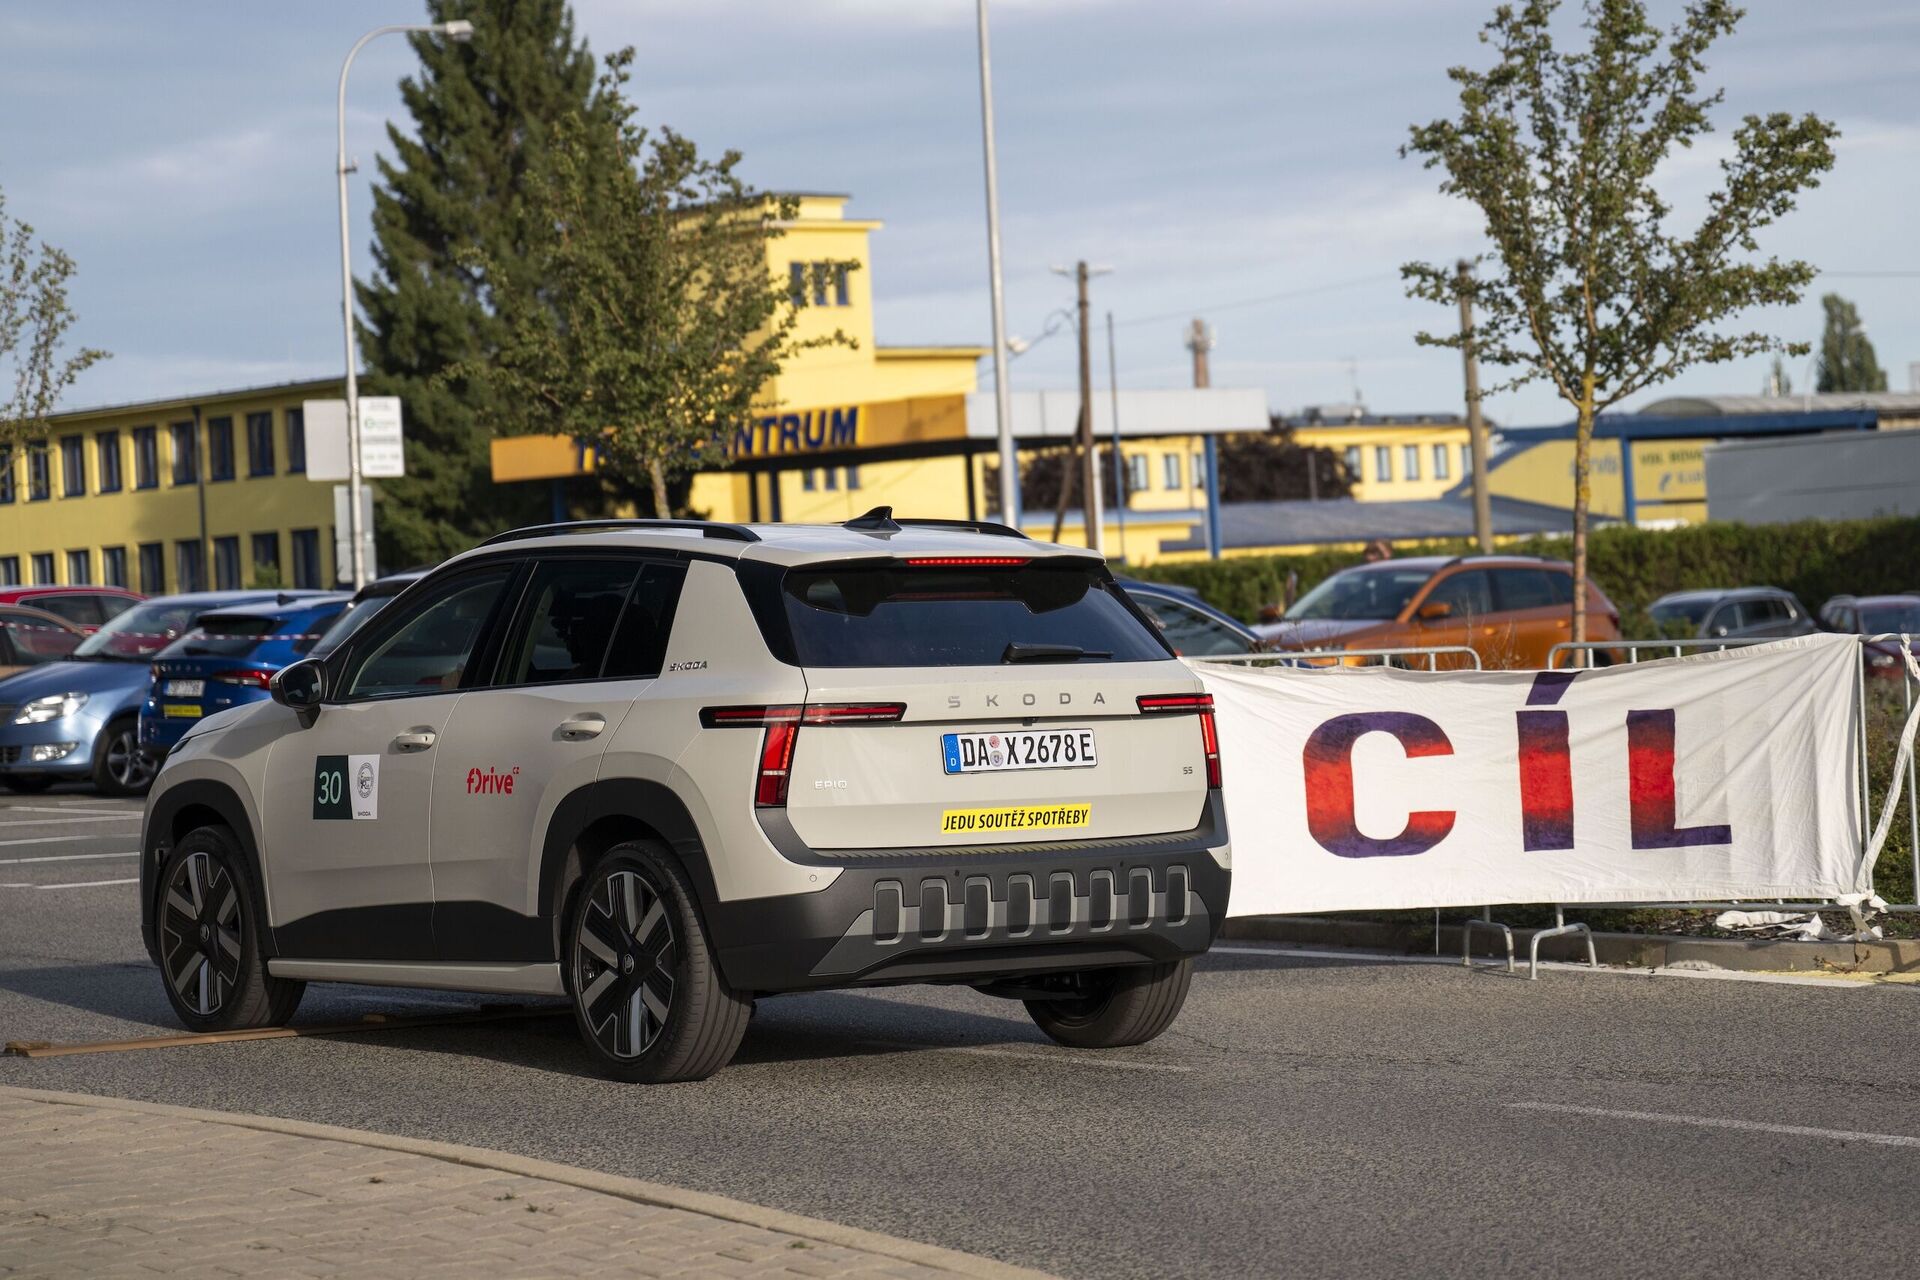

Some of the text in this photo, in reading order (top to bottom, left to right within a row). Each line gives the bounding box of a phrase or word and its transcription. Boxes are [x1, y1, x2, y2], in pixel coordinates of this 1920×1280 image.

[960, 738, 990, 767] DA
[1303, 671, 1732, 858] CÍL
[318, 771, 342, 804] 30
[943, 807, 1089, 831] JEDU SOUTĚŽ SPOTŘEBY
